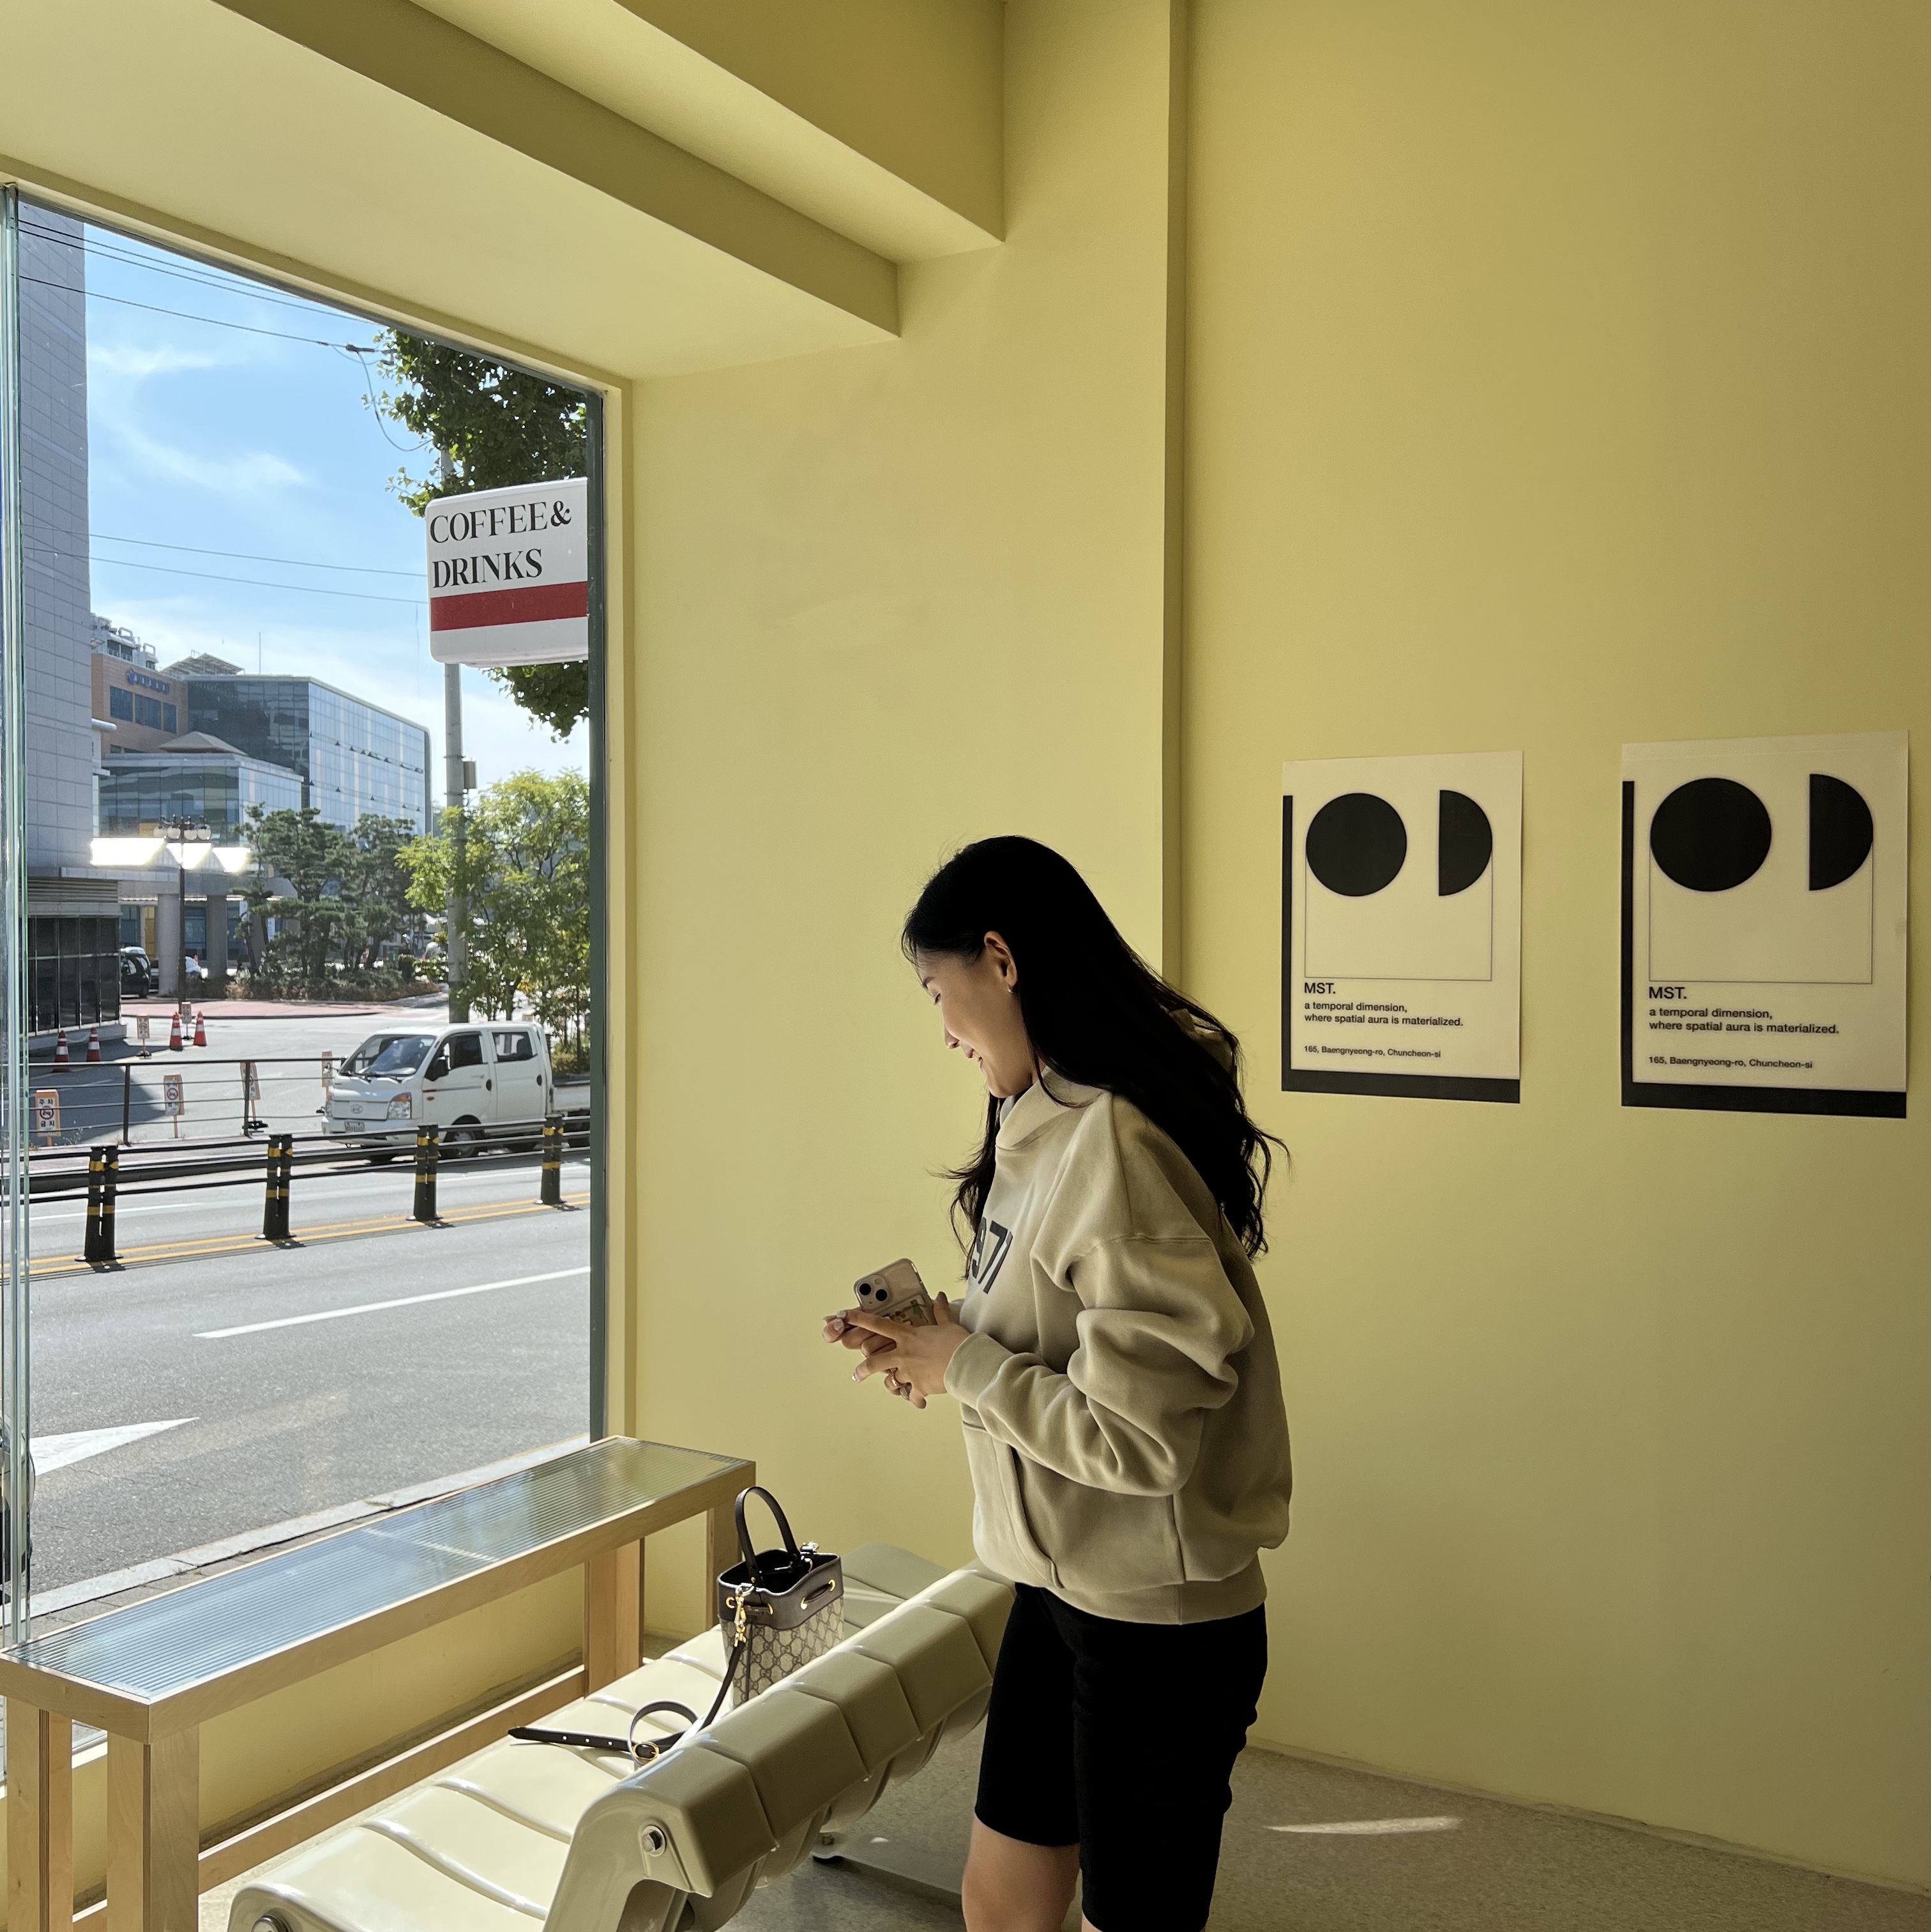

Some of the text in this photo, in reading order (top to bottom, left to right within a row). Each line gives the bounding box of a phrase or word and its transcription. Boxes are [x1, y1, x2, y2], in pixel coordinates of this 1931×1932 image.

[430, 500, 572, 544] COFFEE&
[432, 548, 543, 589] DRINKS
[1305, 982, 1335, 994] MST.
[1649, 987, 1686, 999] MST.
[1313, 1002, 1353, 1011] temporal
[1356, 1003, 1407, 1012] dimension,
[1660, 1008, 1708, 1018] temporal
[1712, 1008, 1772, 1019] dimension,
[1305, 1014, 1331, 1022] where
[1335, 1015, 1365, 1024] spatial
[1391, 1015, 1399, 1024] is
[1402, 1017, 1463, 1026] materialized.
[1649, 1021, 1682, 1030] where
[1686, 1022, 1722, 1031] spatial
[1754, 1023, 1763, 1031] is
[1767, 1024, 1838, 1033] materialized.
[1322, 1046, 1385, 1056] Baengnyeong-ro,
[1388, 1049, 1441, 1057] Chuncheon-si
[1670, 1057, 1746, 1067] Baengnyeong-ro,
[1749, 1059, 1812, 1069] Chuncheon-si
